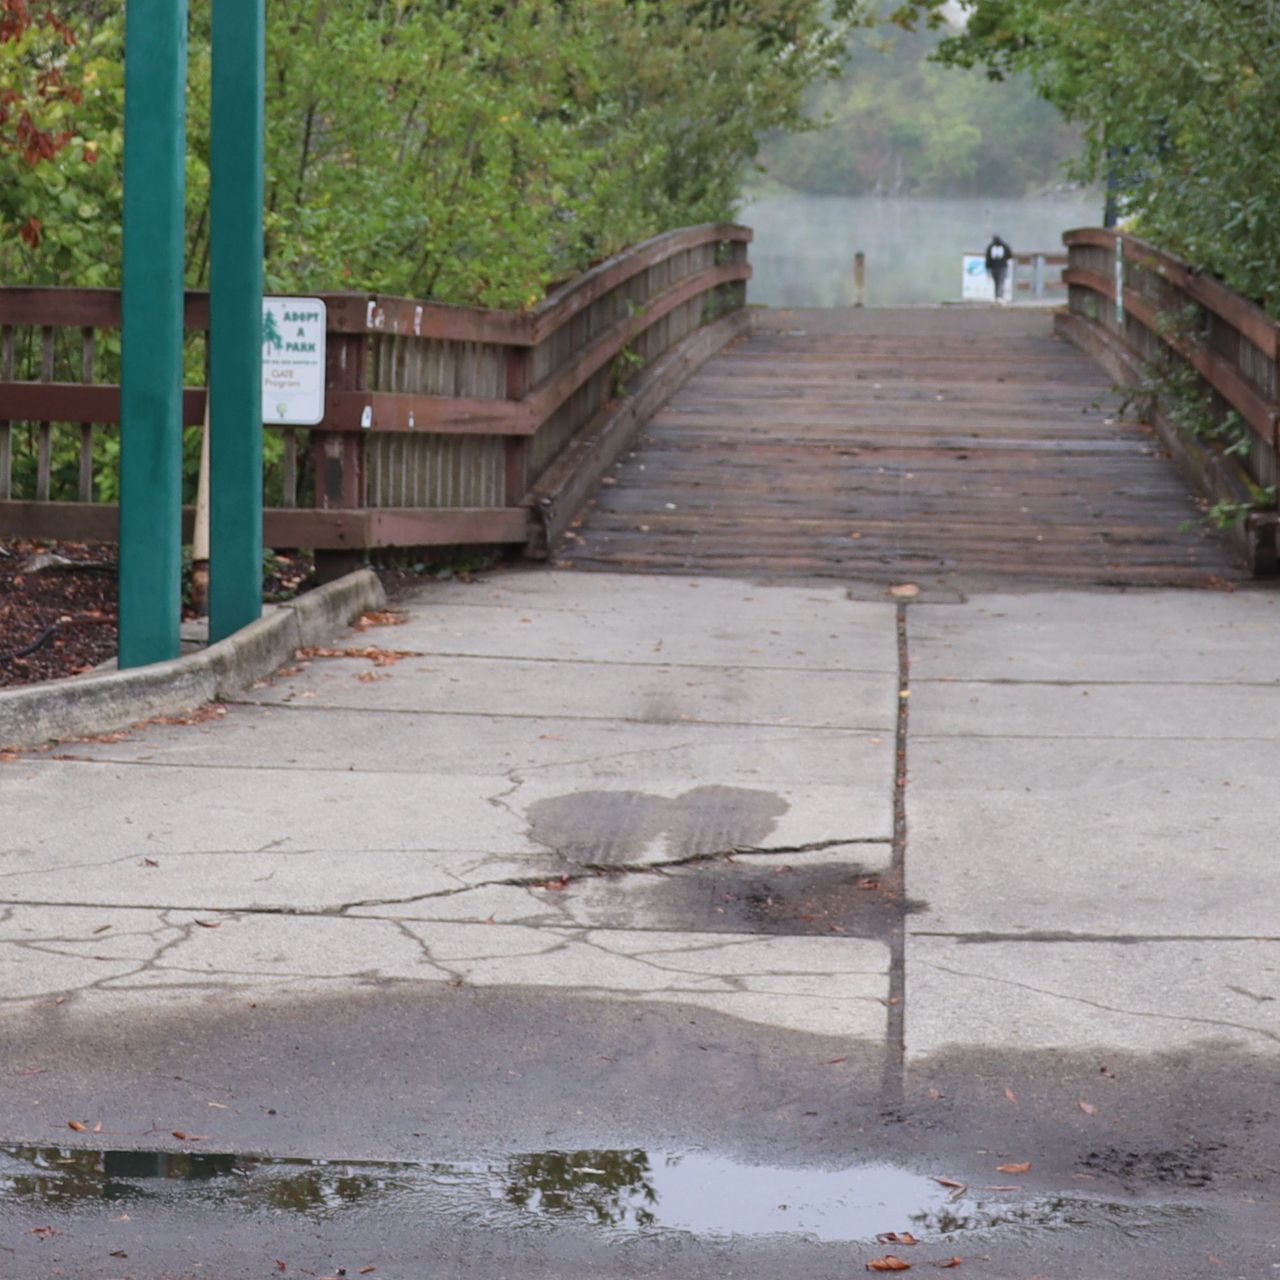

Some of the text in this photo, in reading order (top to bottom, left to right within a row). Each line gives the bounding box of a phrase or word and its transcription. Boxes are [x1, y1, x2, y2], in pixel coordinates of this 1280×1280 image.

[283, 311, 319, 322] ADOPT
[297, 327, 305, 337] A
[285, 342, 316, 353] PARK
